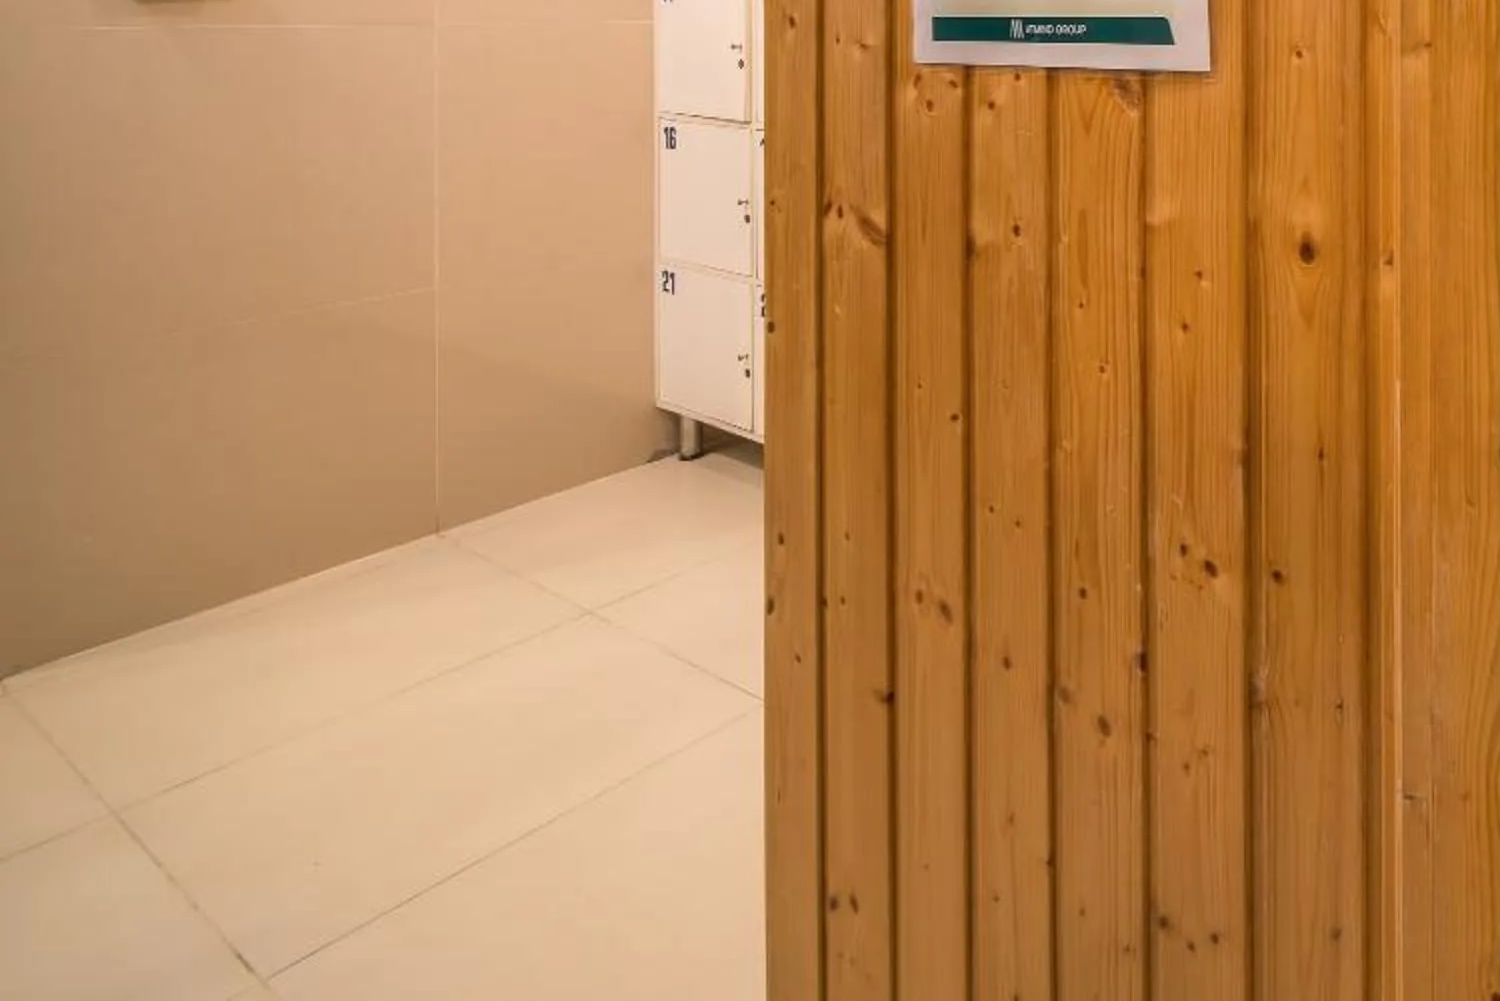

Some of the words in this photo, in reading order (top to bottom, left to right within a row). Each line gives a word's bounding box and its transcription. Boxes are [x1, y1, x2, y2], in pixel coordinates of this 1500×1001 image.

[1056, 24, 1087, 35] GROUP
[663, 126, 677, 149] 16
[661, 270, 675, 295] 21
